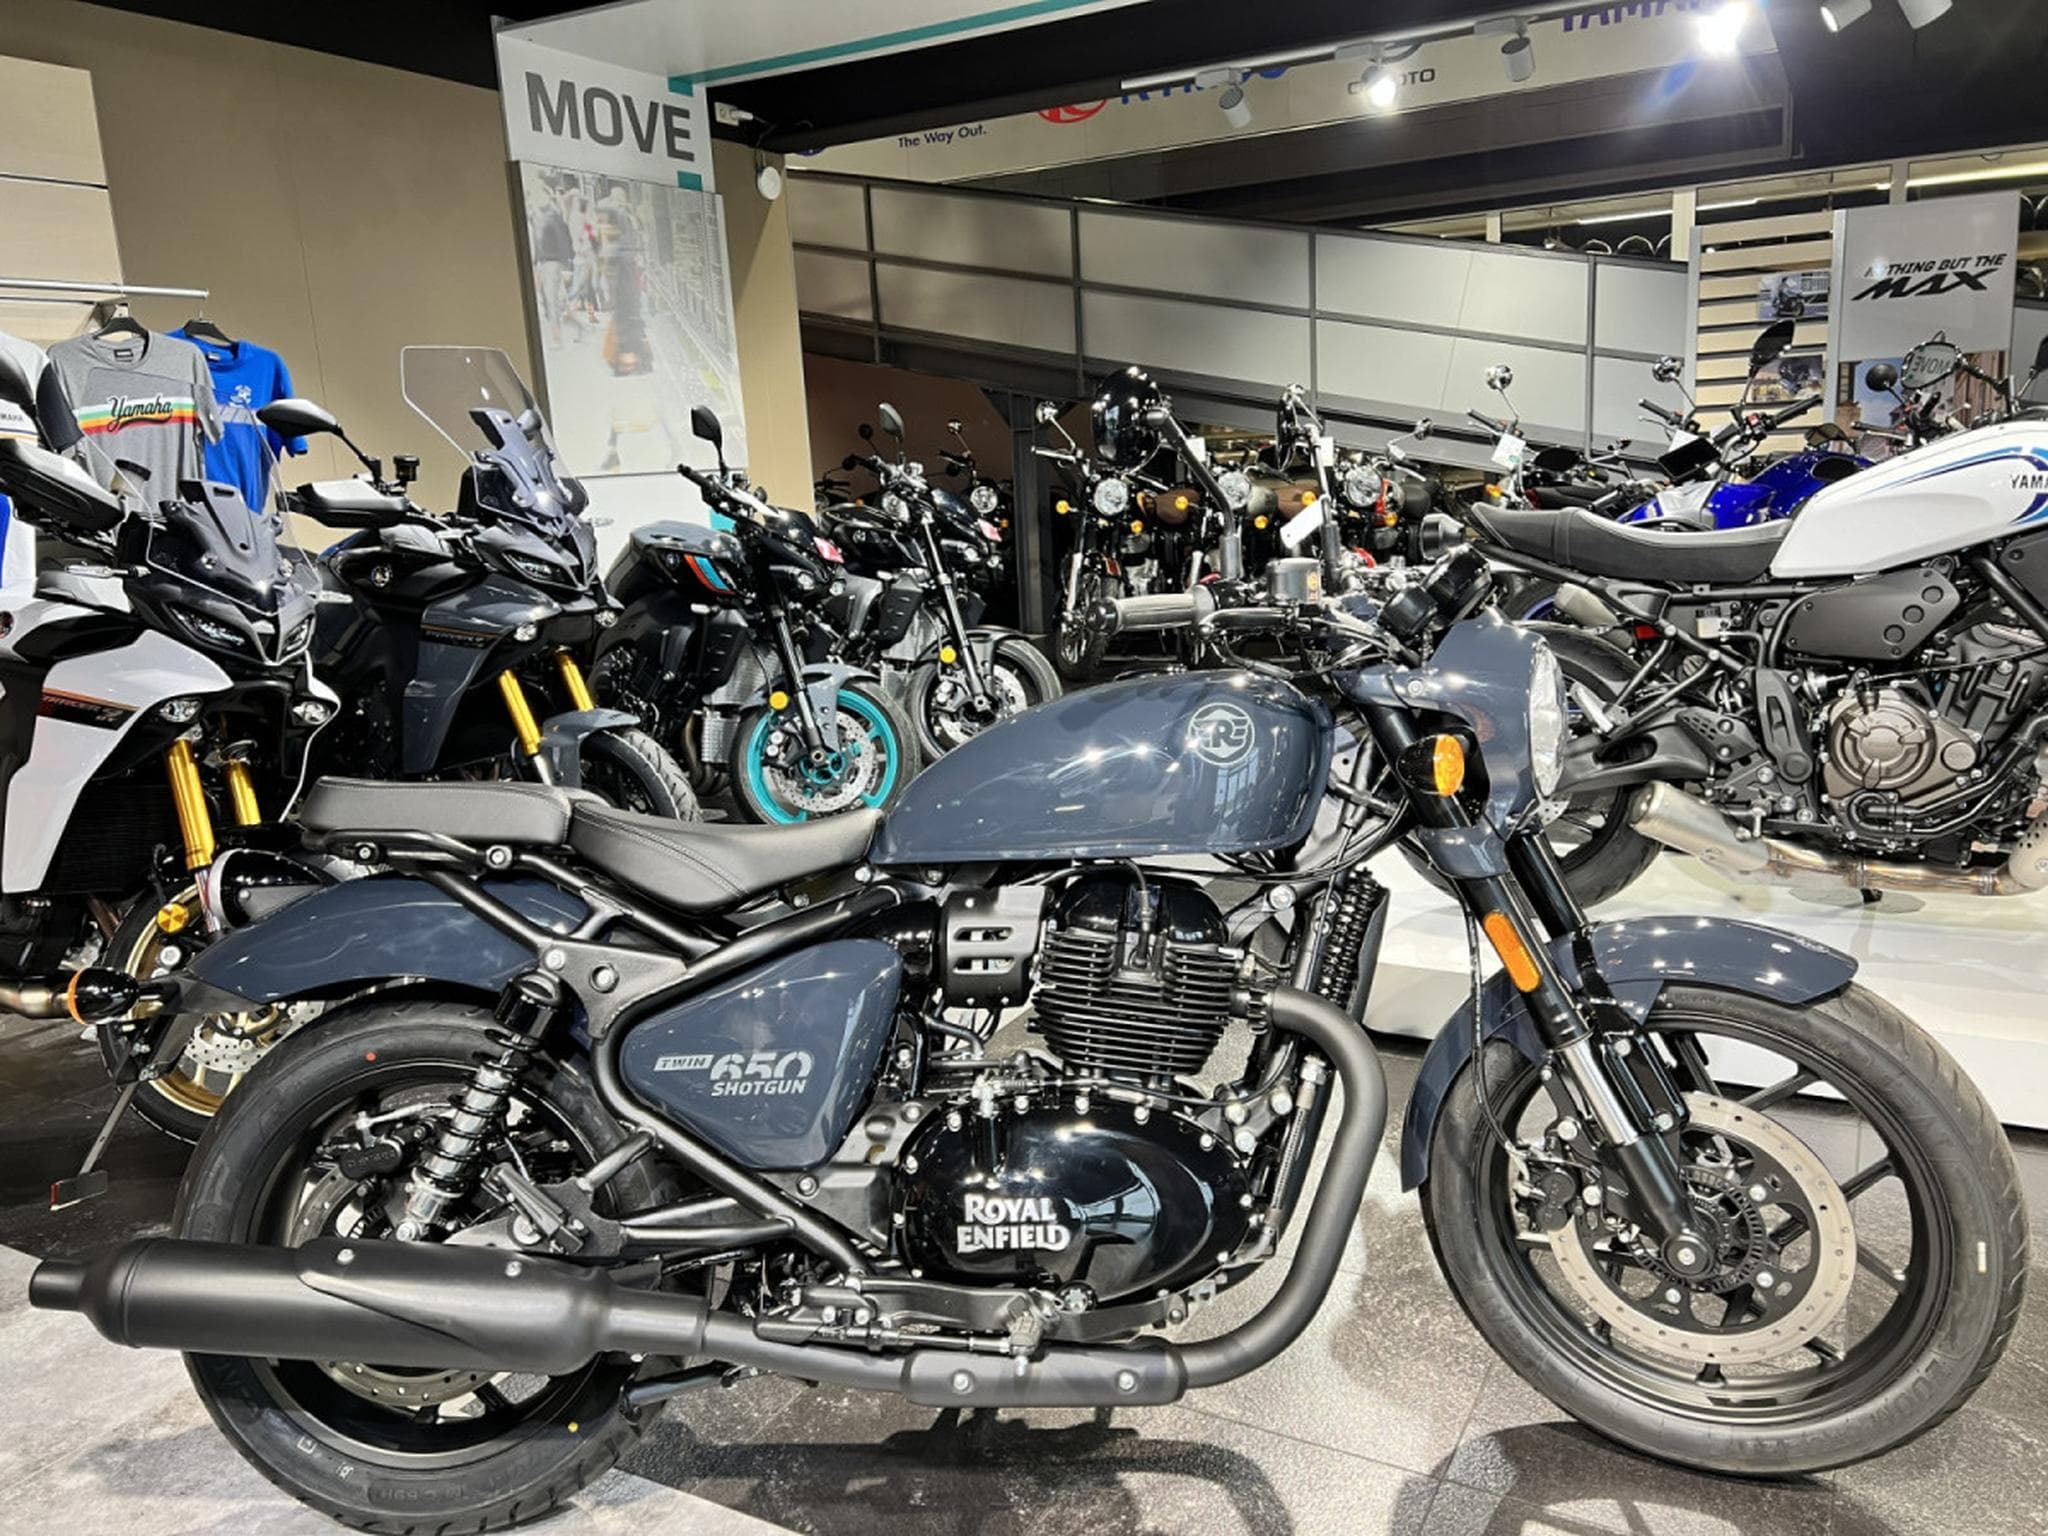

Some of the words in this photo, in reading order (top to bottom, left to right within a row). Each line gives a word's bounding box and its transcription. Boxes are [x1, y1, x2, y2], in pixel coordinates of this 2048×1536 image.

[525, 71, 695, 162] MOVE
[898, 136, 921, 148] The
[923, 129, 954, 145] Way
[957, 124, 988, 139] Out.
[1864, 260, 1936, 278] THING
[1937, 256, 1972, 271] BUT
[1974, 253, 2007, 267] THE
[1851, 267, 1999, 301] MAX
[106, 393, 173, 432] Yamaha
[659, 1055, 708, 1070] TWIN
[710, 1051, 813, 1080] 650
[711, 1079, 806, 1097] SHOTGUN
[963, 1193, 1057, 1226] ROYAL
[956, 1224, 1071, 1254] ENFIELD
